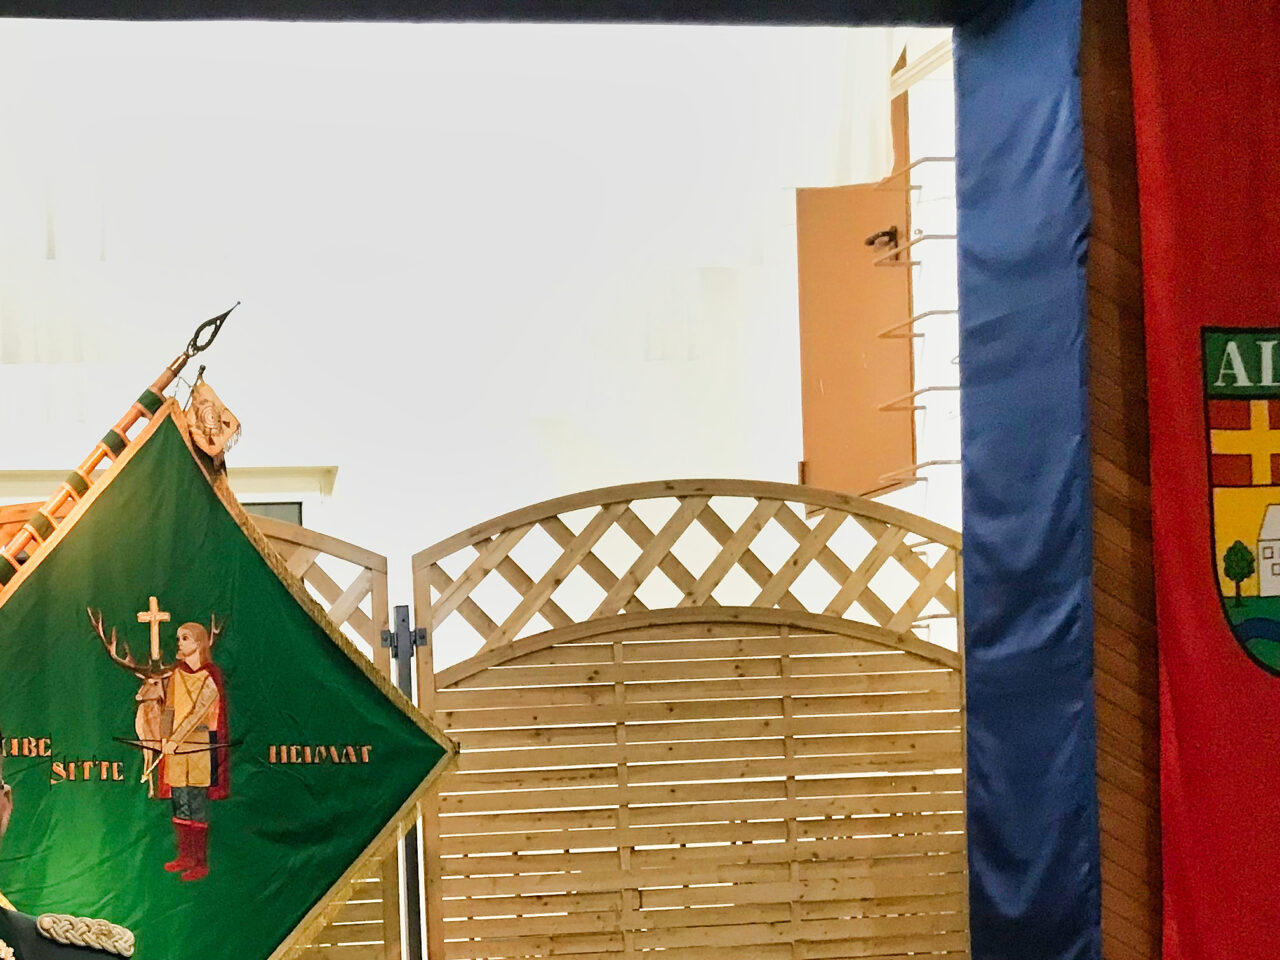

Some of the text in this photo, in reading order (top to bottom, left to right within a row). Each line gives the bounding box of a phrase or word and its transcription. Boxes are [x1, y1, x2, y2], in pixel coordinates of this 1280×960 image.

[1213, 340, 1280, 387] AL
[268, 744, 373, 764] HEIMAT
[50, 760, 125, 785] SITTE
